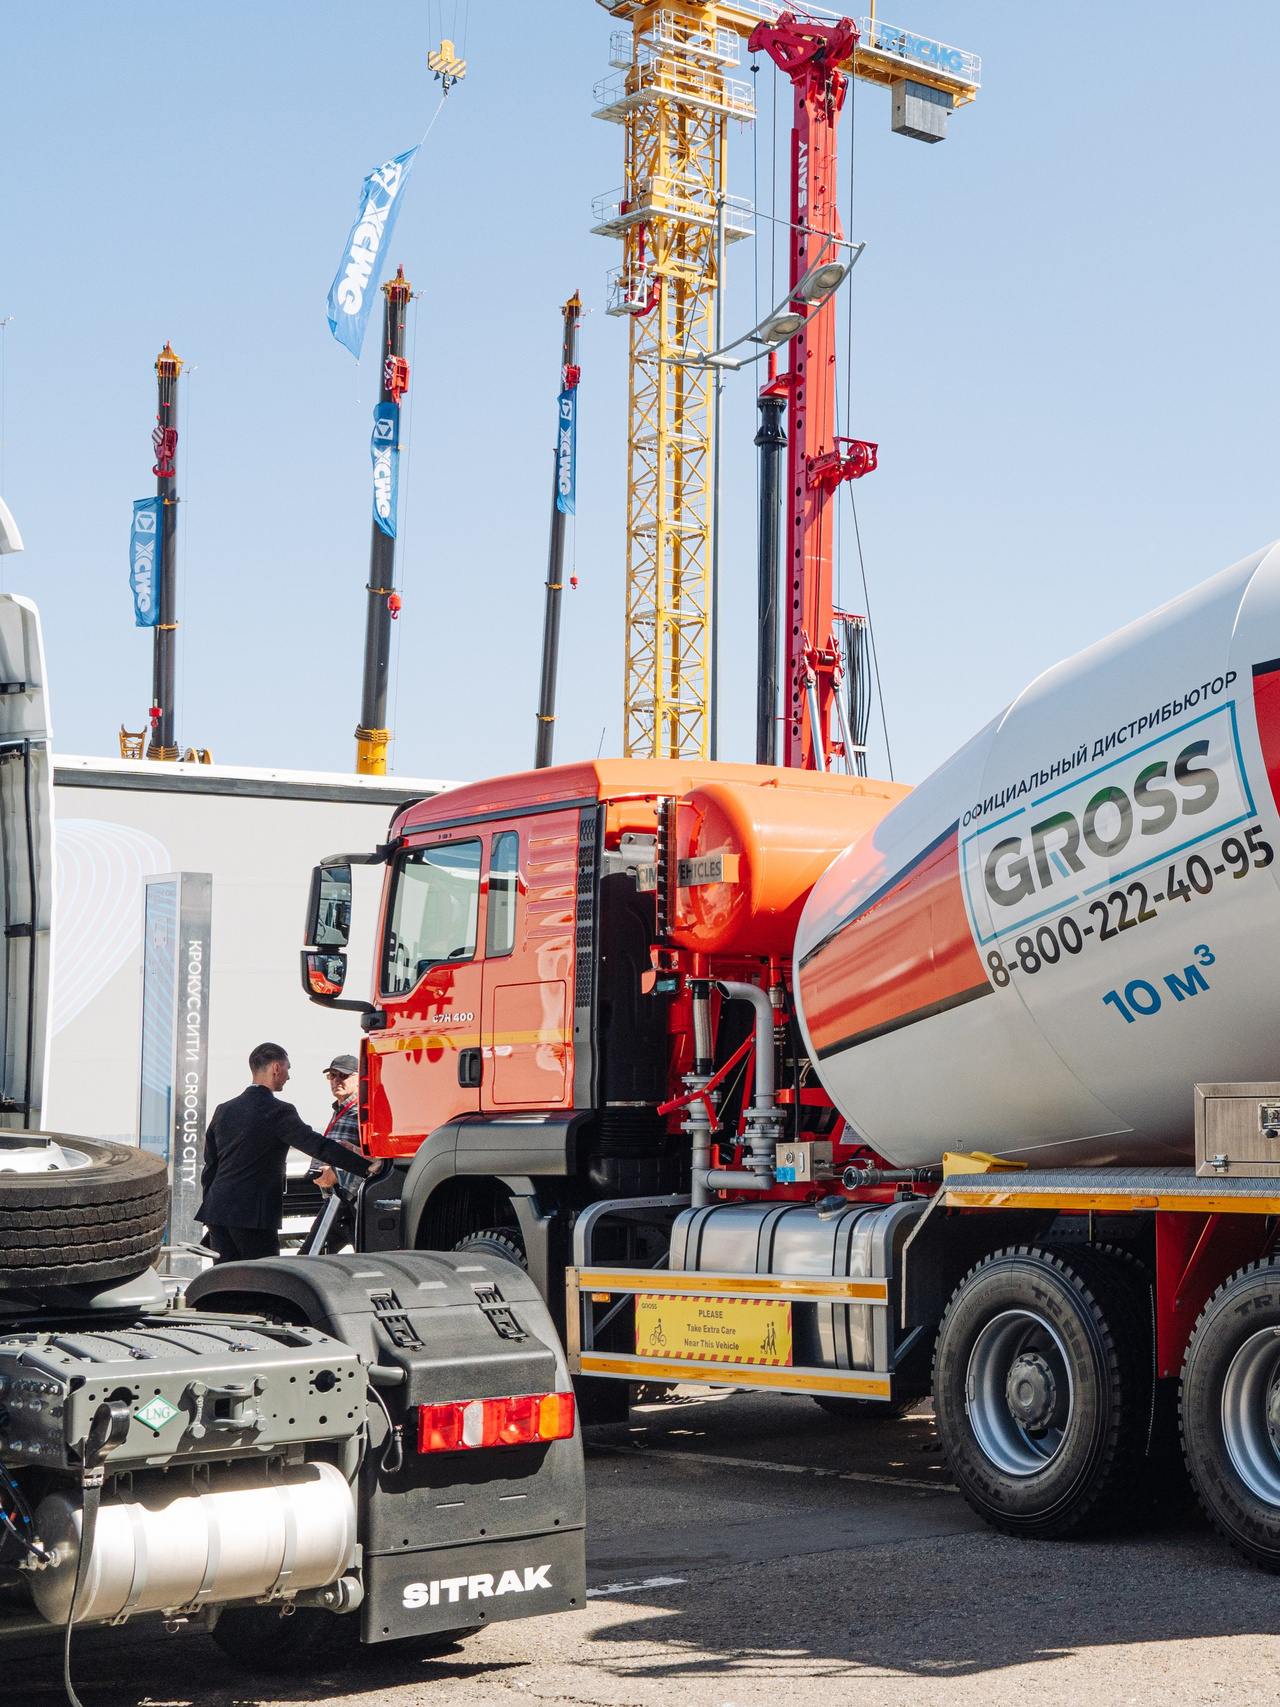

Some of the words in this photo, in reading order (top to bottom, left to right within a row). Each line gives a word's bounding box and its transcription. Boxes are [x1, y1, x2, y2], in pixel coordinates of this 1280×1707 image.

[798, 141, 808, 209] SANY
[962, 744, 1087, 827] ОФИЦИАЛЬНЫЙ
[1091, 670, 1237, 761] ДИСТРИБЬЮТОР
[984, 739, 1220, 907] GROSS
[987, 824, 1275, 988] 8-800-222-40-95
[187, 940, 202, 1009] КРОКУС
[453, 1012, 474, 1023] 400
[1102, 979, 1161, 1024] 10
[185, 1011, 201, 1061] СИТИ
[183, 1072, 199, 1144] CROCUS
[182, 1147, 197, 1185] CITY
[698, 1309, 723, 1319] PLEASE
[1235, 1295, 1274, 1317] TR
[684, 1338, 699, 1347] Near
[700, 1339, 714, 1348] This
[716, 1341, 739, 1351] Vehicle
[687, 1323, 702, 1332] Take
[703, 1325, 720, 1334] Extra
[721, 1326, 736, 1335] Care
[146, 1406, 170, 1420] LNG
[402, 1564, 553, 1609] SITRAK
